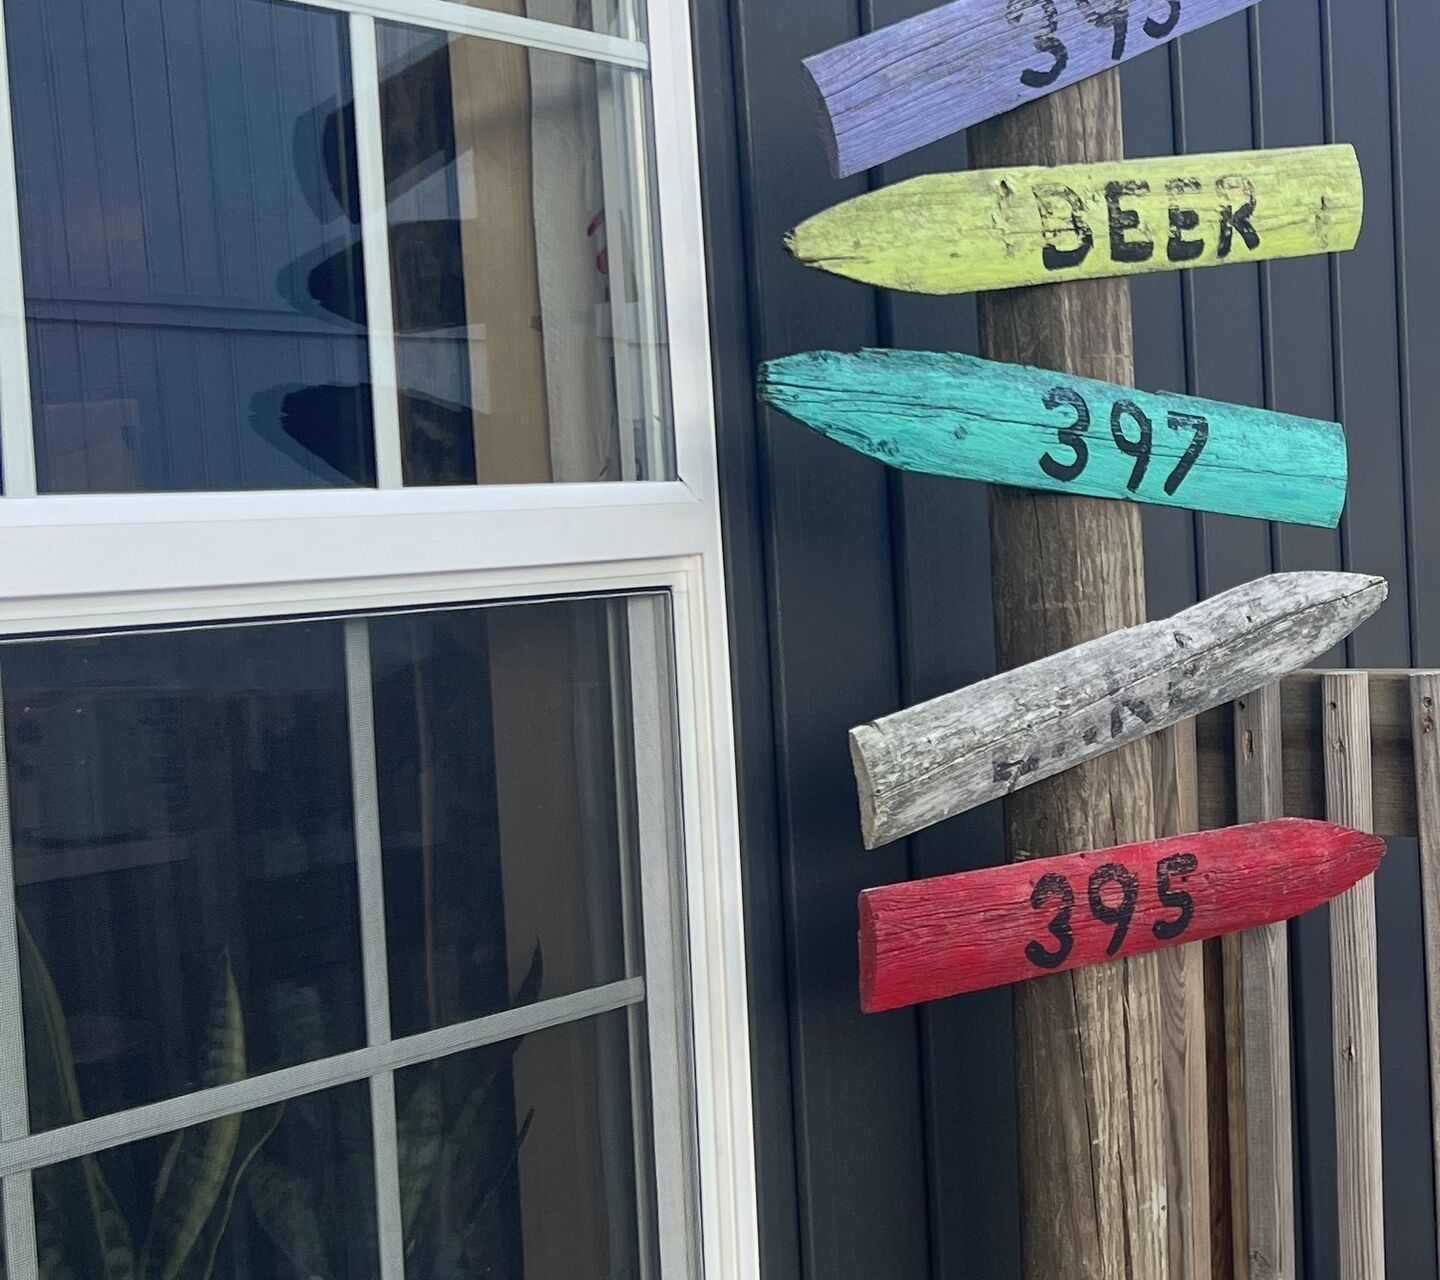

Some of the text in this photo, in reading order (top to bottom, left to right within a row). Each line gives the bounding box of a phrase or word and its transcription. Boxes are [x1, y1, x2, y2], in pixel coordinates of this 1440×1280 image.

[1032, 174, 1259, 270] BEER
[1039, 387, 1210, 497] 397
[1025, 852, 1199, 969] 395
